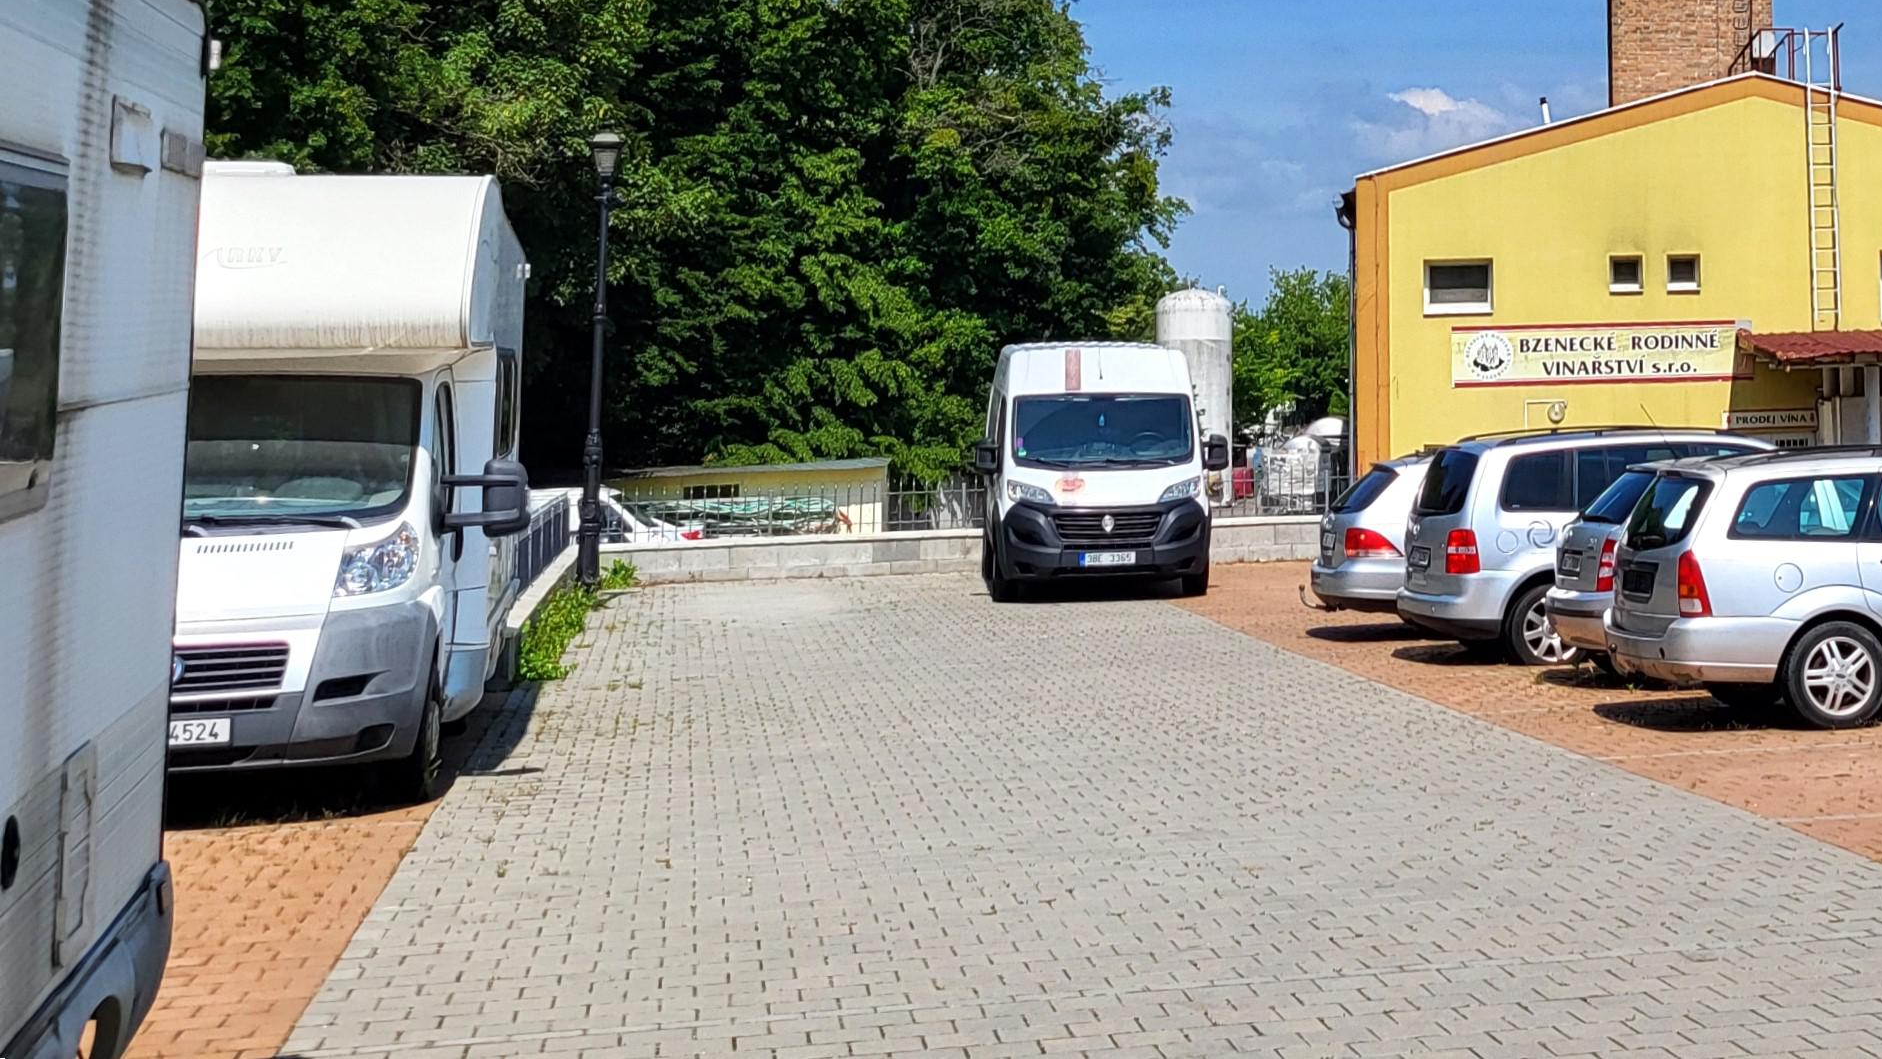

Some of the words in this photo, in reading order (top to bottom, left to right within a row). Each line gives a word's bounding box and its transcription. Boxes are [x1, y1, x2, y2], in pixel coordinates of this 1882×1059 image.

[1518, 332, 1616, 354] BZENECKÉ
[1631, 327, 1720, 350] RODINNÉ
[1541, 354, 1645, 376] VINAŘSTVÍ
[1651, 360, 1697, 375] s.r.o.
[1735, 415, 1776, 425] PRODEJ
[1780, 413, 1807, 422] VÍNA
[170, 722, 220, 743] 4524
